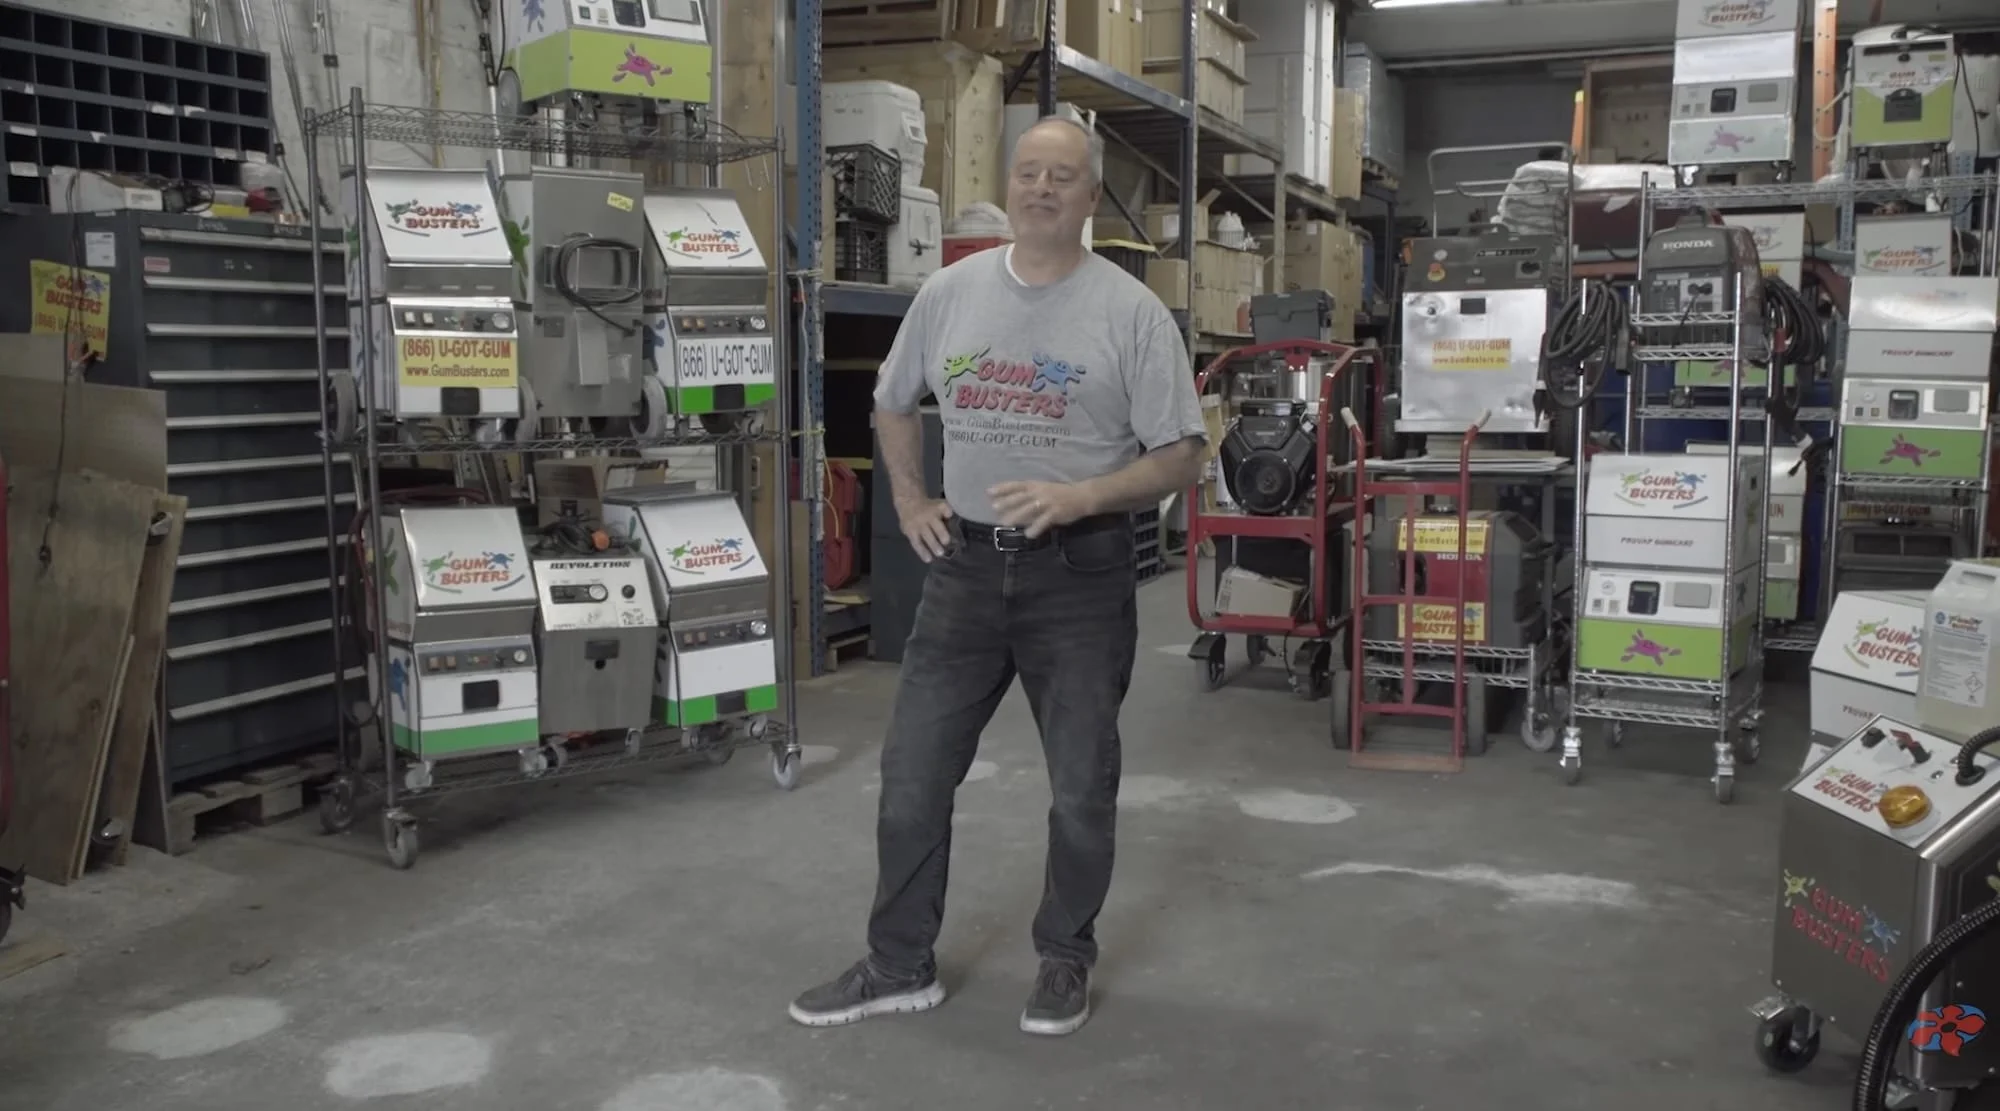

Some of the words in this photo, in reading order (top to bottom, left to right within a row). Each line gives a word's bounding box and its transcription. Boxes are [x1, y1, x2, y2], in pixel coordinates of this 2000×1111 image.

[416, 206, 455, 217] GUM
[406, 218, 480, 229] BUSTERS
[687, 233, 721, 243] GUM
[1662, 240, 1714, 249] HONDA
[682, 242, 740, 253] BUSTERS
[403, 338, 434, 361] (866)
[439, 339, 511, 359] U-GOT-GUM
[679, 344, 707, 380] (866)
[711, 344, 772, 377] U-GOT-GUM
[406, 364, 510, 378] www.GumBusters.com
[977, 358, 1036, 388] GUM
[955, 384, 1067, 419] BUSTERS
[1642, 475, 1677, 486] GUM
[1630, 488, 1695, 500] BUSTERS
[690, 544, 722, 556] GUM
[450, 558, 490, 571] GUM
[685, 553, 742, 569] BUSTERS
[440, 571, 510, 585] BUSTERS
[1876, 627, 1913, 646] GUM
[1839, 773, 1876, 795] GUM
[1814, 779, 1878, 813] BUSTERS
[1811, 887, 1864, 935] GUM
[1792, 904, 1889, 983] BUSTERS
